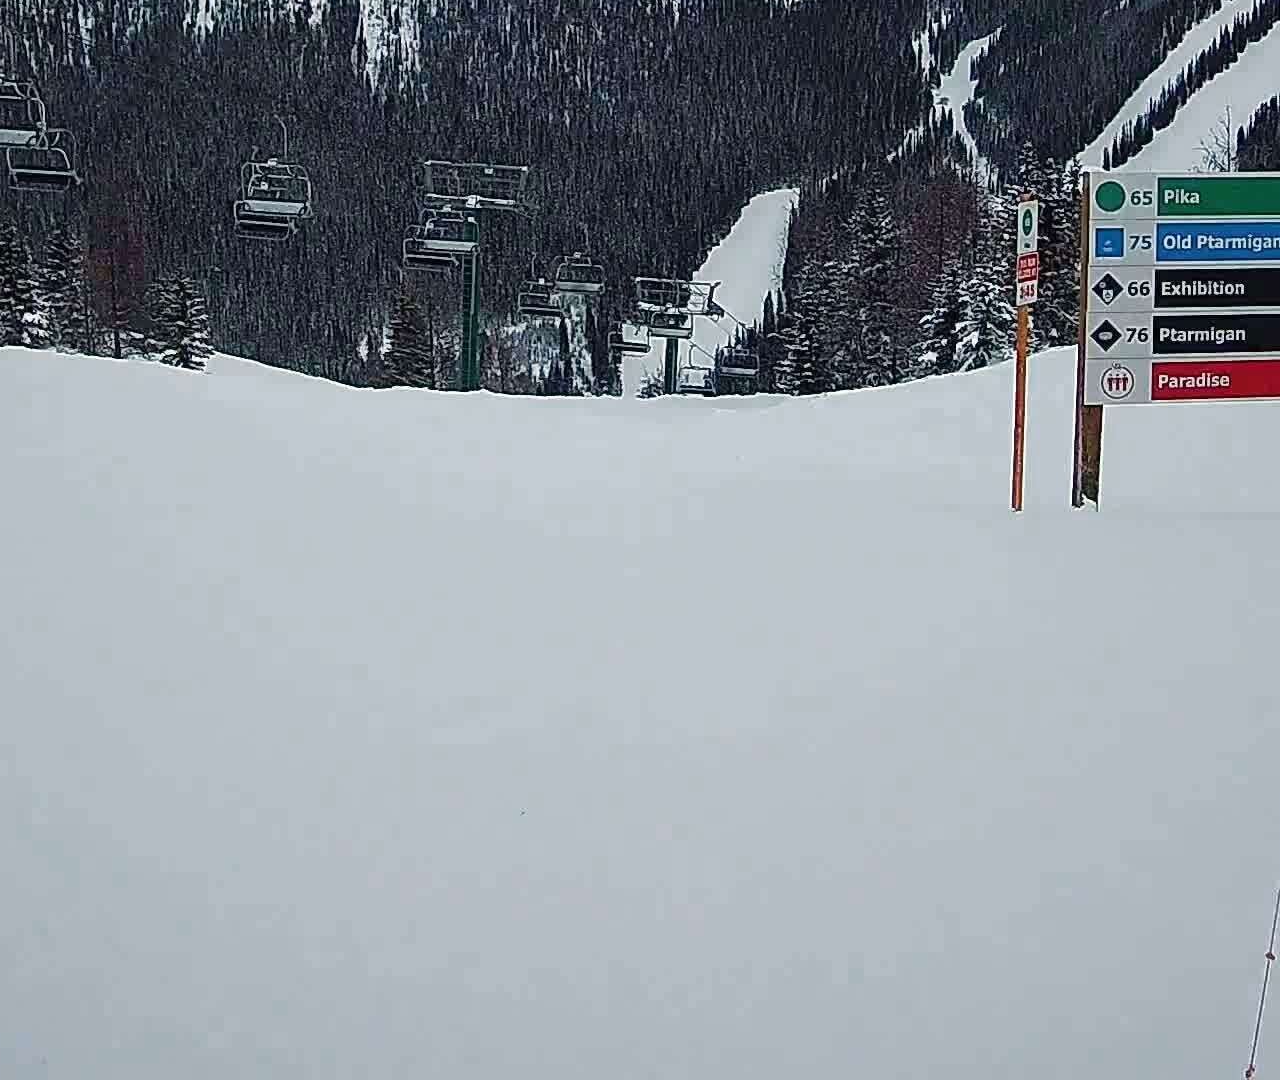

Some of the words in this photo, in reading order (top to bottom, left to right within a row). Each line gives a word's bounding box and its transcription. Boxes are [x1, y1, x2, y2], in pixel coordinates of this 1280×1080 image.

[1130, 191, 1153, 206] 65
[1164, 189, 1200, 204] Pika
[1129, 235, 1152, 250] 75
[1163, 235, 1191, 249] Old
[1127, 281, 1150, 296] 66
[1161, 281, 1245, 296] Exhibition
[1126, 327, 1149, 343] 76
[1159, 326, 1246, 344] Ptarmigan
[1158, 373, 1230, 389] Paradise
